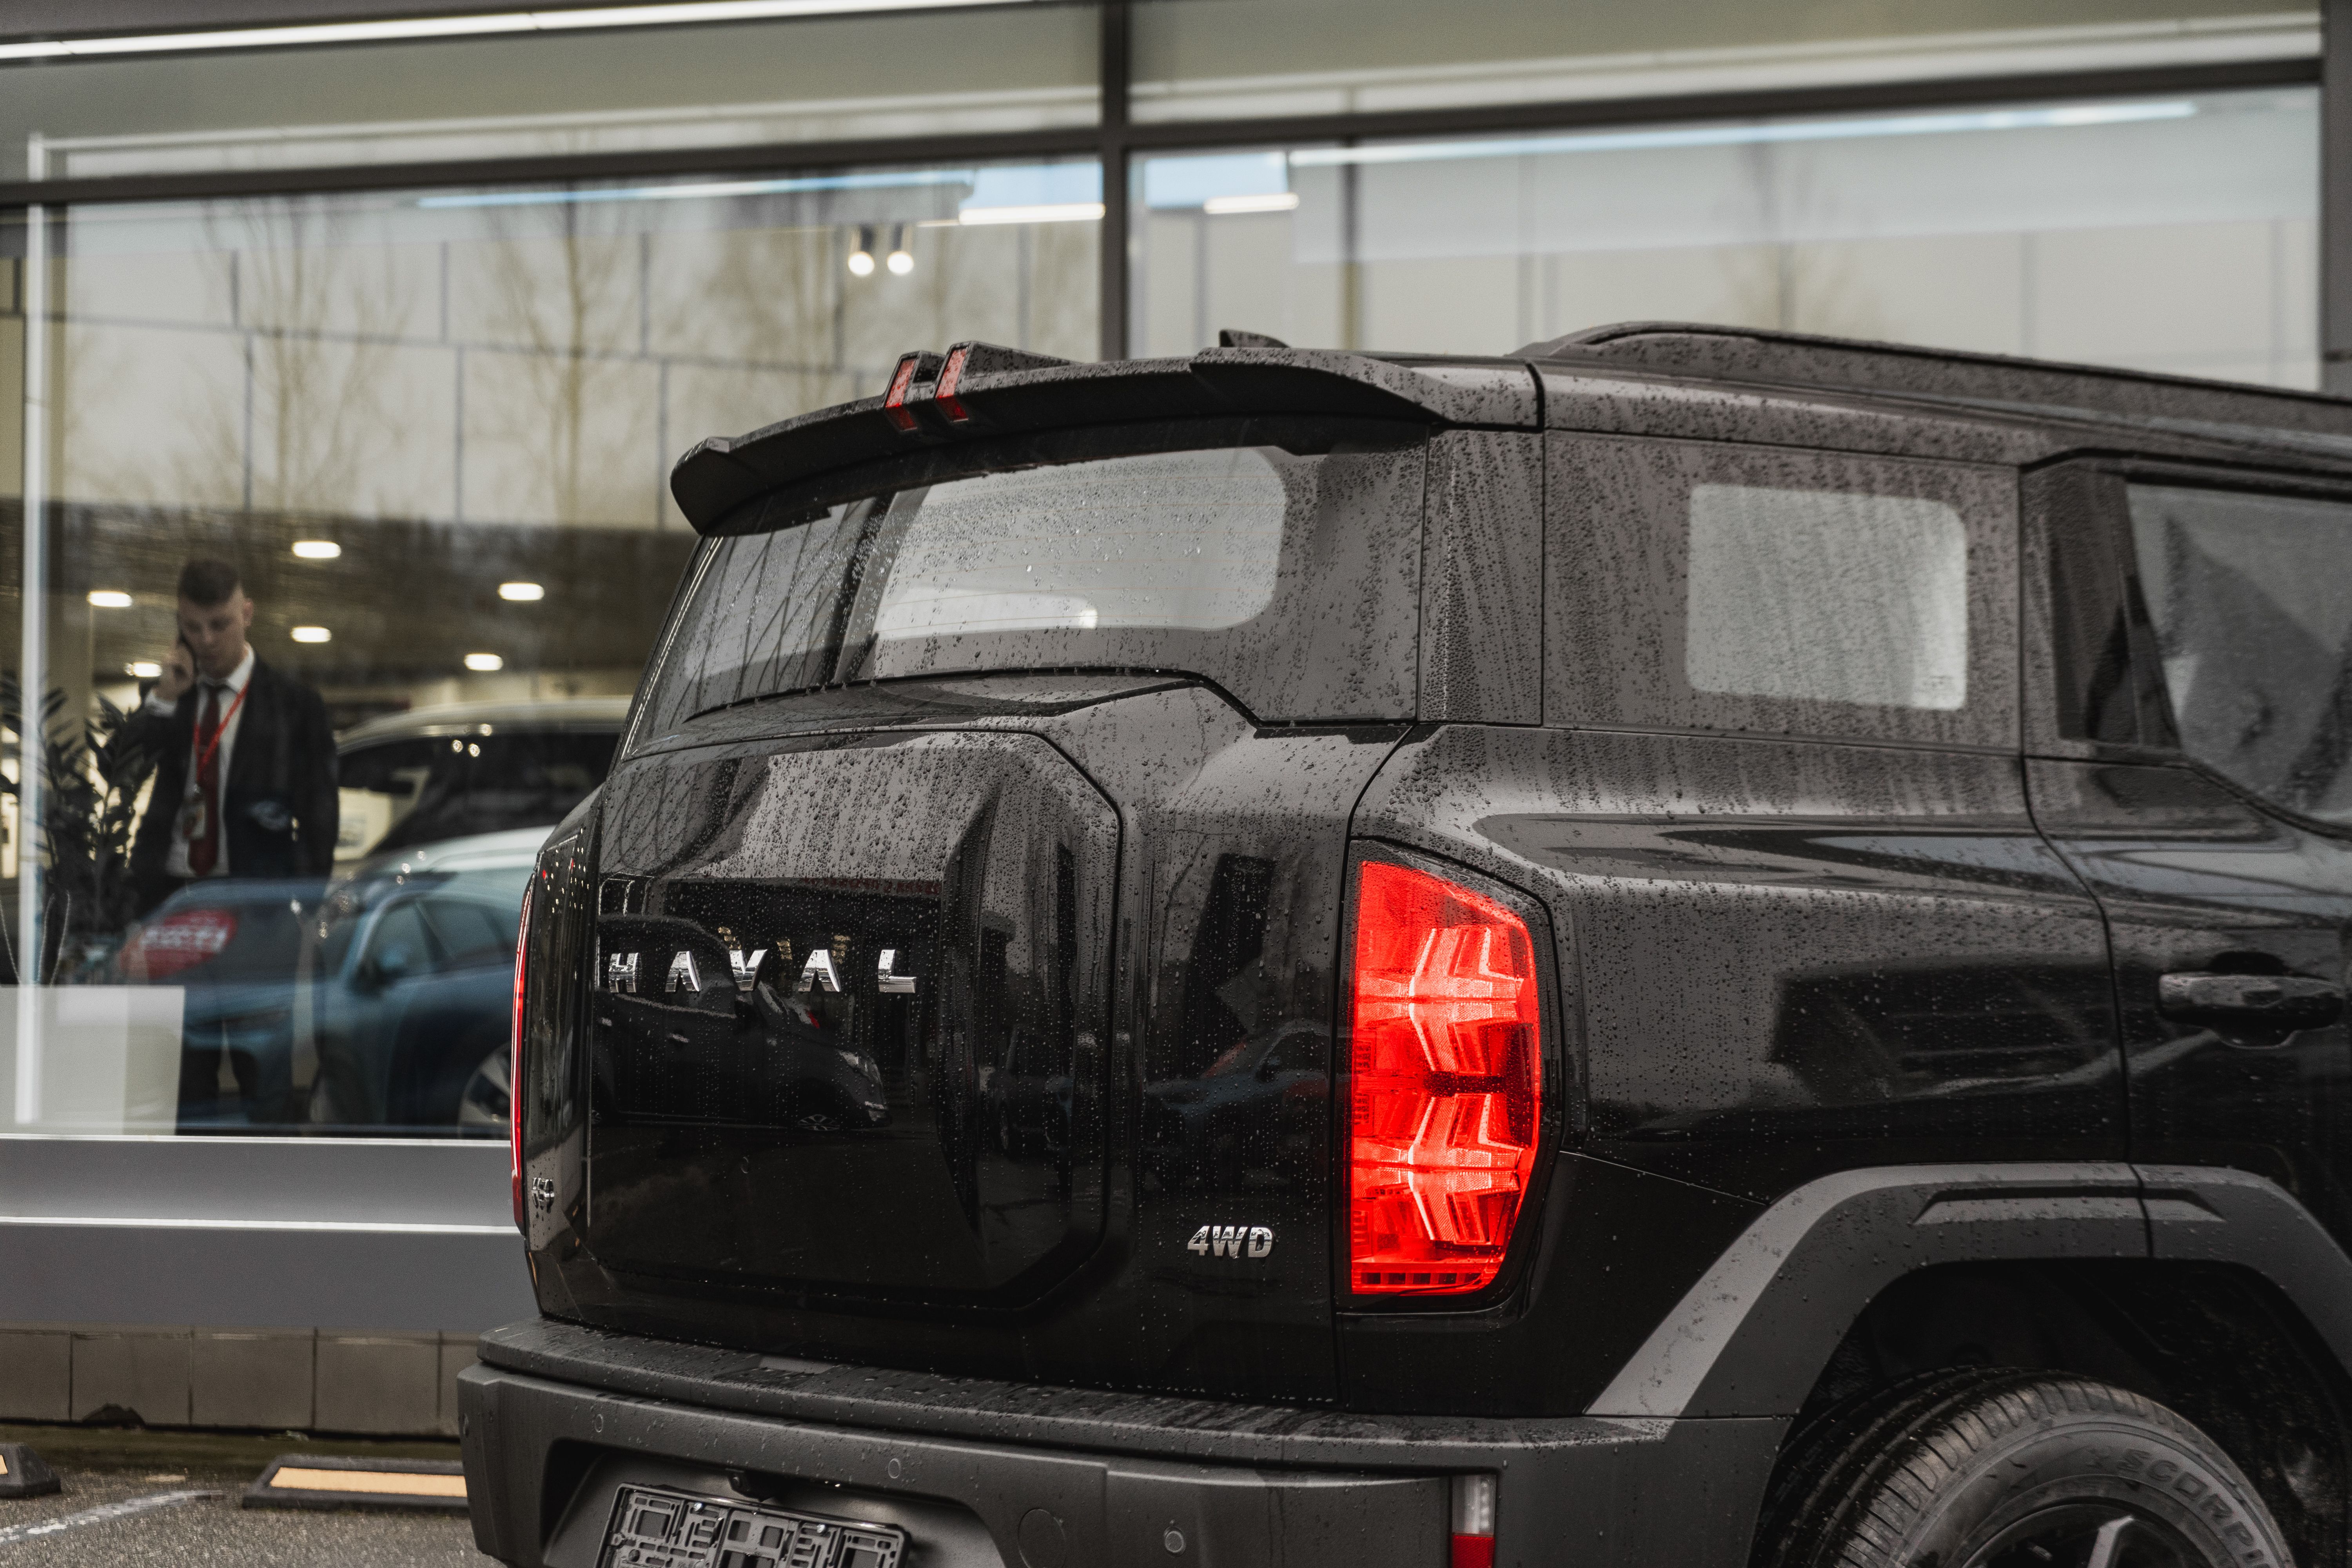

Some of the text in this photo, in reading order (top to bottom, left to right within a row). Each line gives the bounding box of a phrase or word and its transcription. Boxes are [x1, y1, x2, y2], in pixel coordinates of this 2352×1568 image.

[608, 949, 916, 993] HAVAL
[1187, 1225, 1274, 1258] 4WD
[2116, 1448, 2272, 1568] SCORPI
